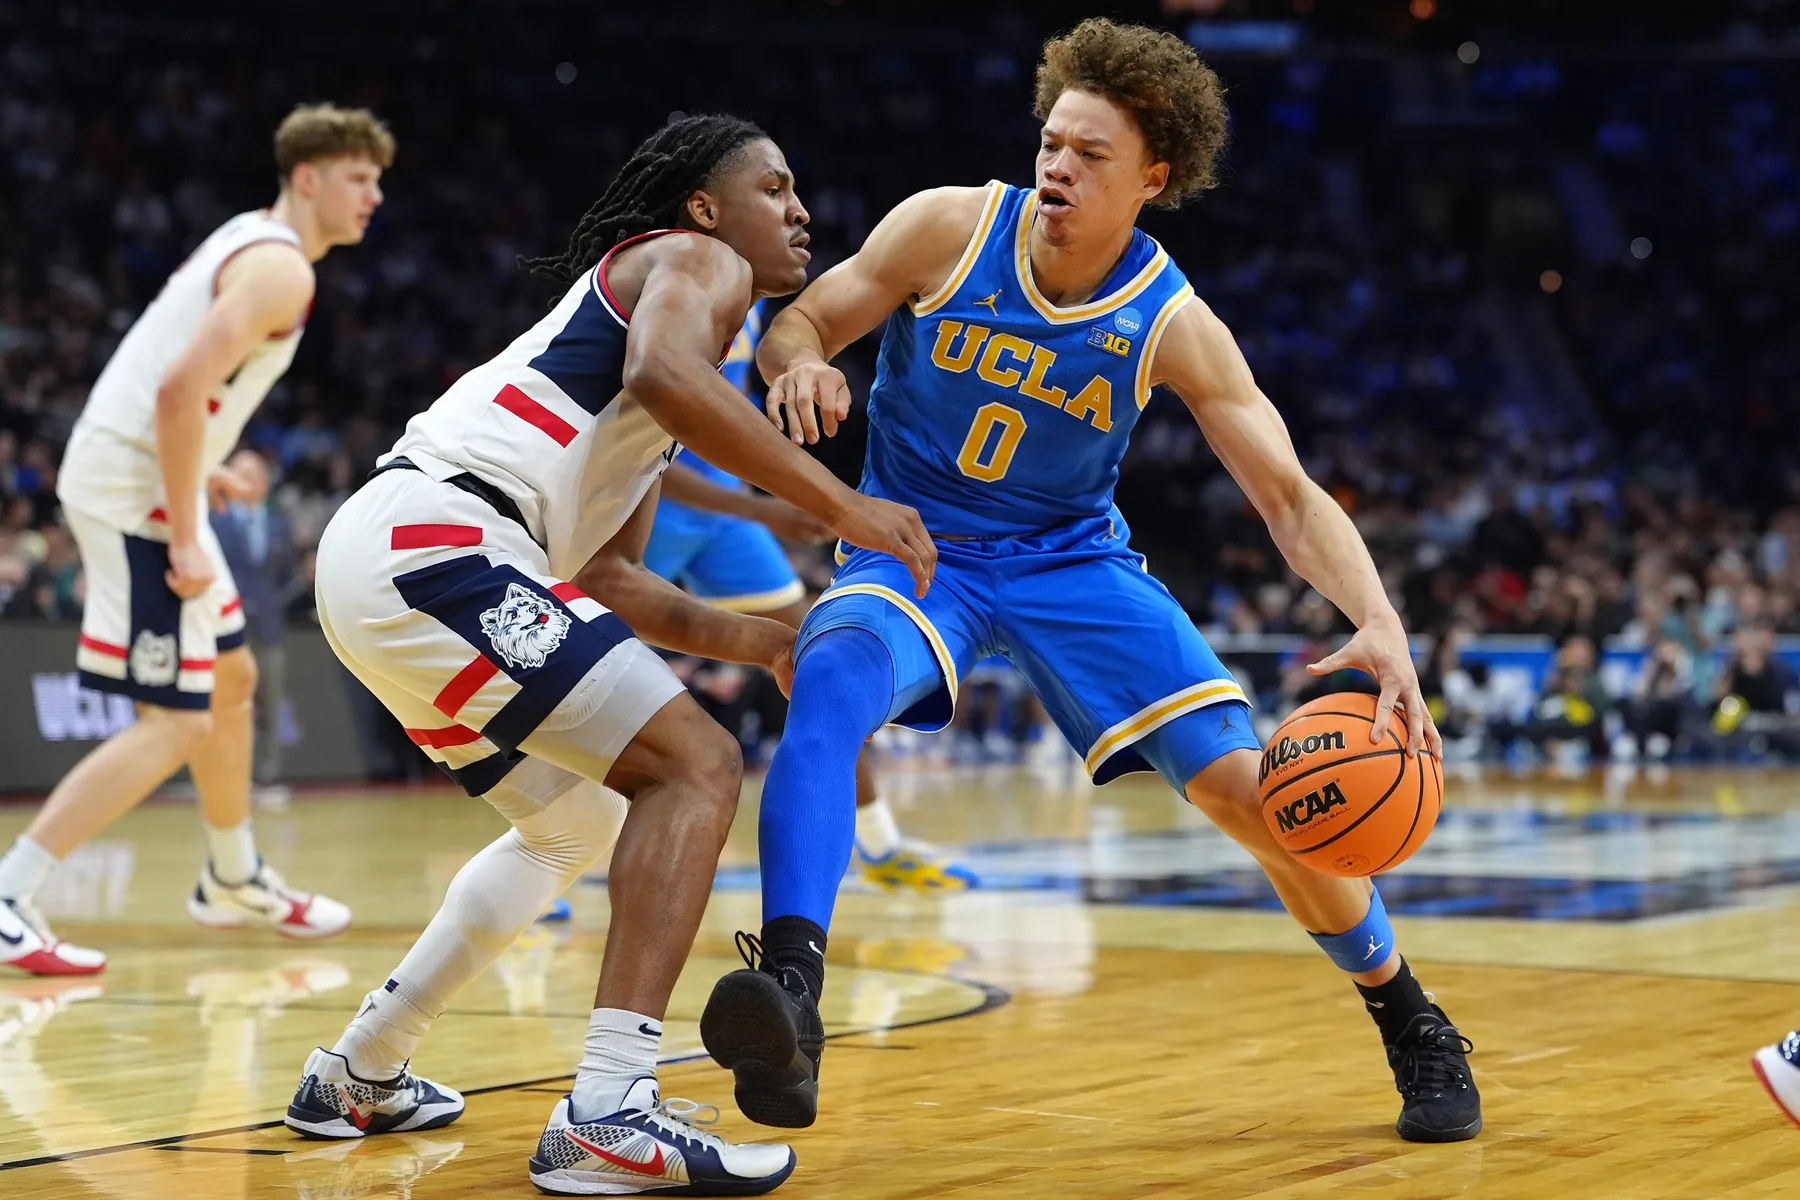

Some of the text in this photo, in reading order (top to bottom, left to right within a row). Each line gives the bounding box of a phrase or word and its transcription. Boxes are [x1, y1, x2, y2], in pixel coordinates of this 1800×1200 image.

[1116, 316, 1140, 331] NCAA
[931, 320, 1113, 433] UCLA
[956, 402, 1028, 483] 0
[1258, 731, 1347, 787] Wilson
[1275, 758, 1304, 777] EVO NXT
[1274, 781, 1347, 834] NCAA
[1308, 816, 1330, 830] GAME
[1329, 807, 1352, 819] BALL
